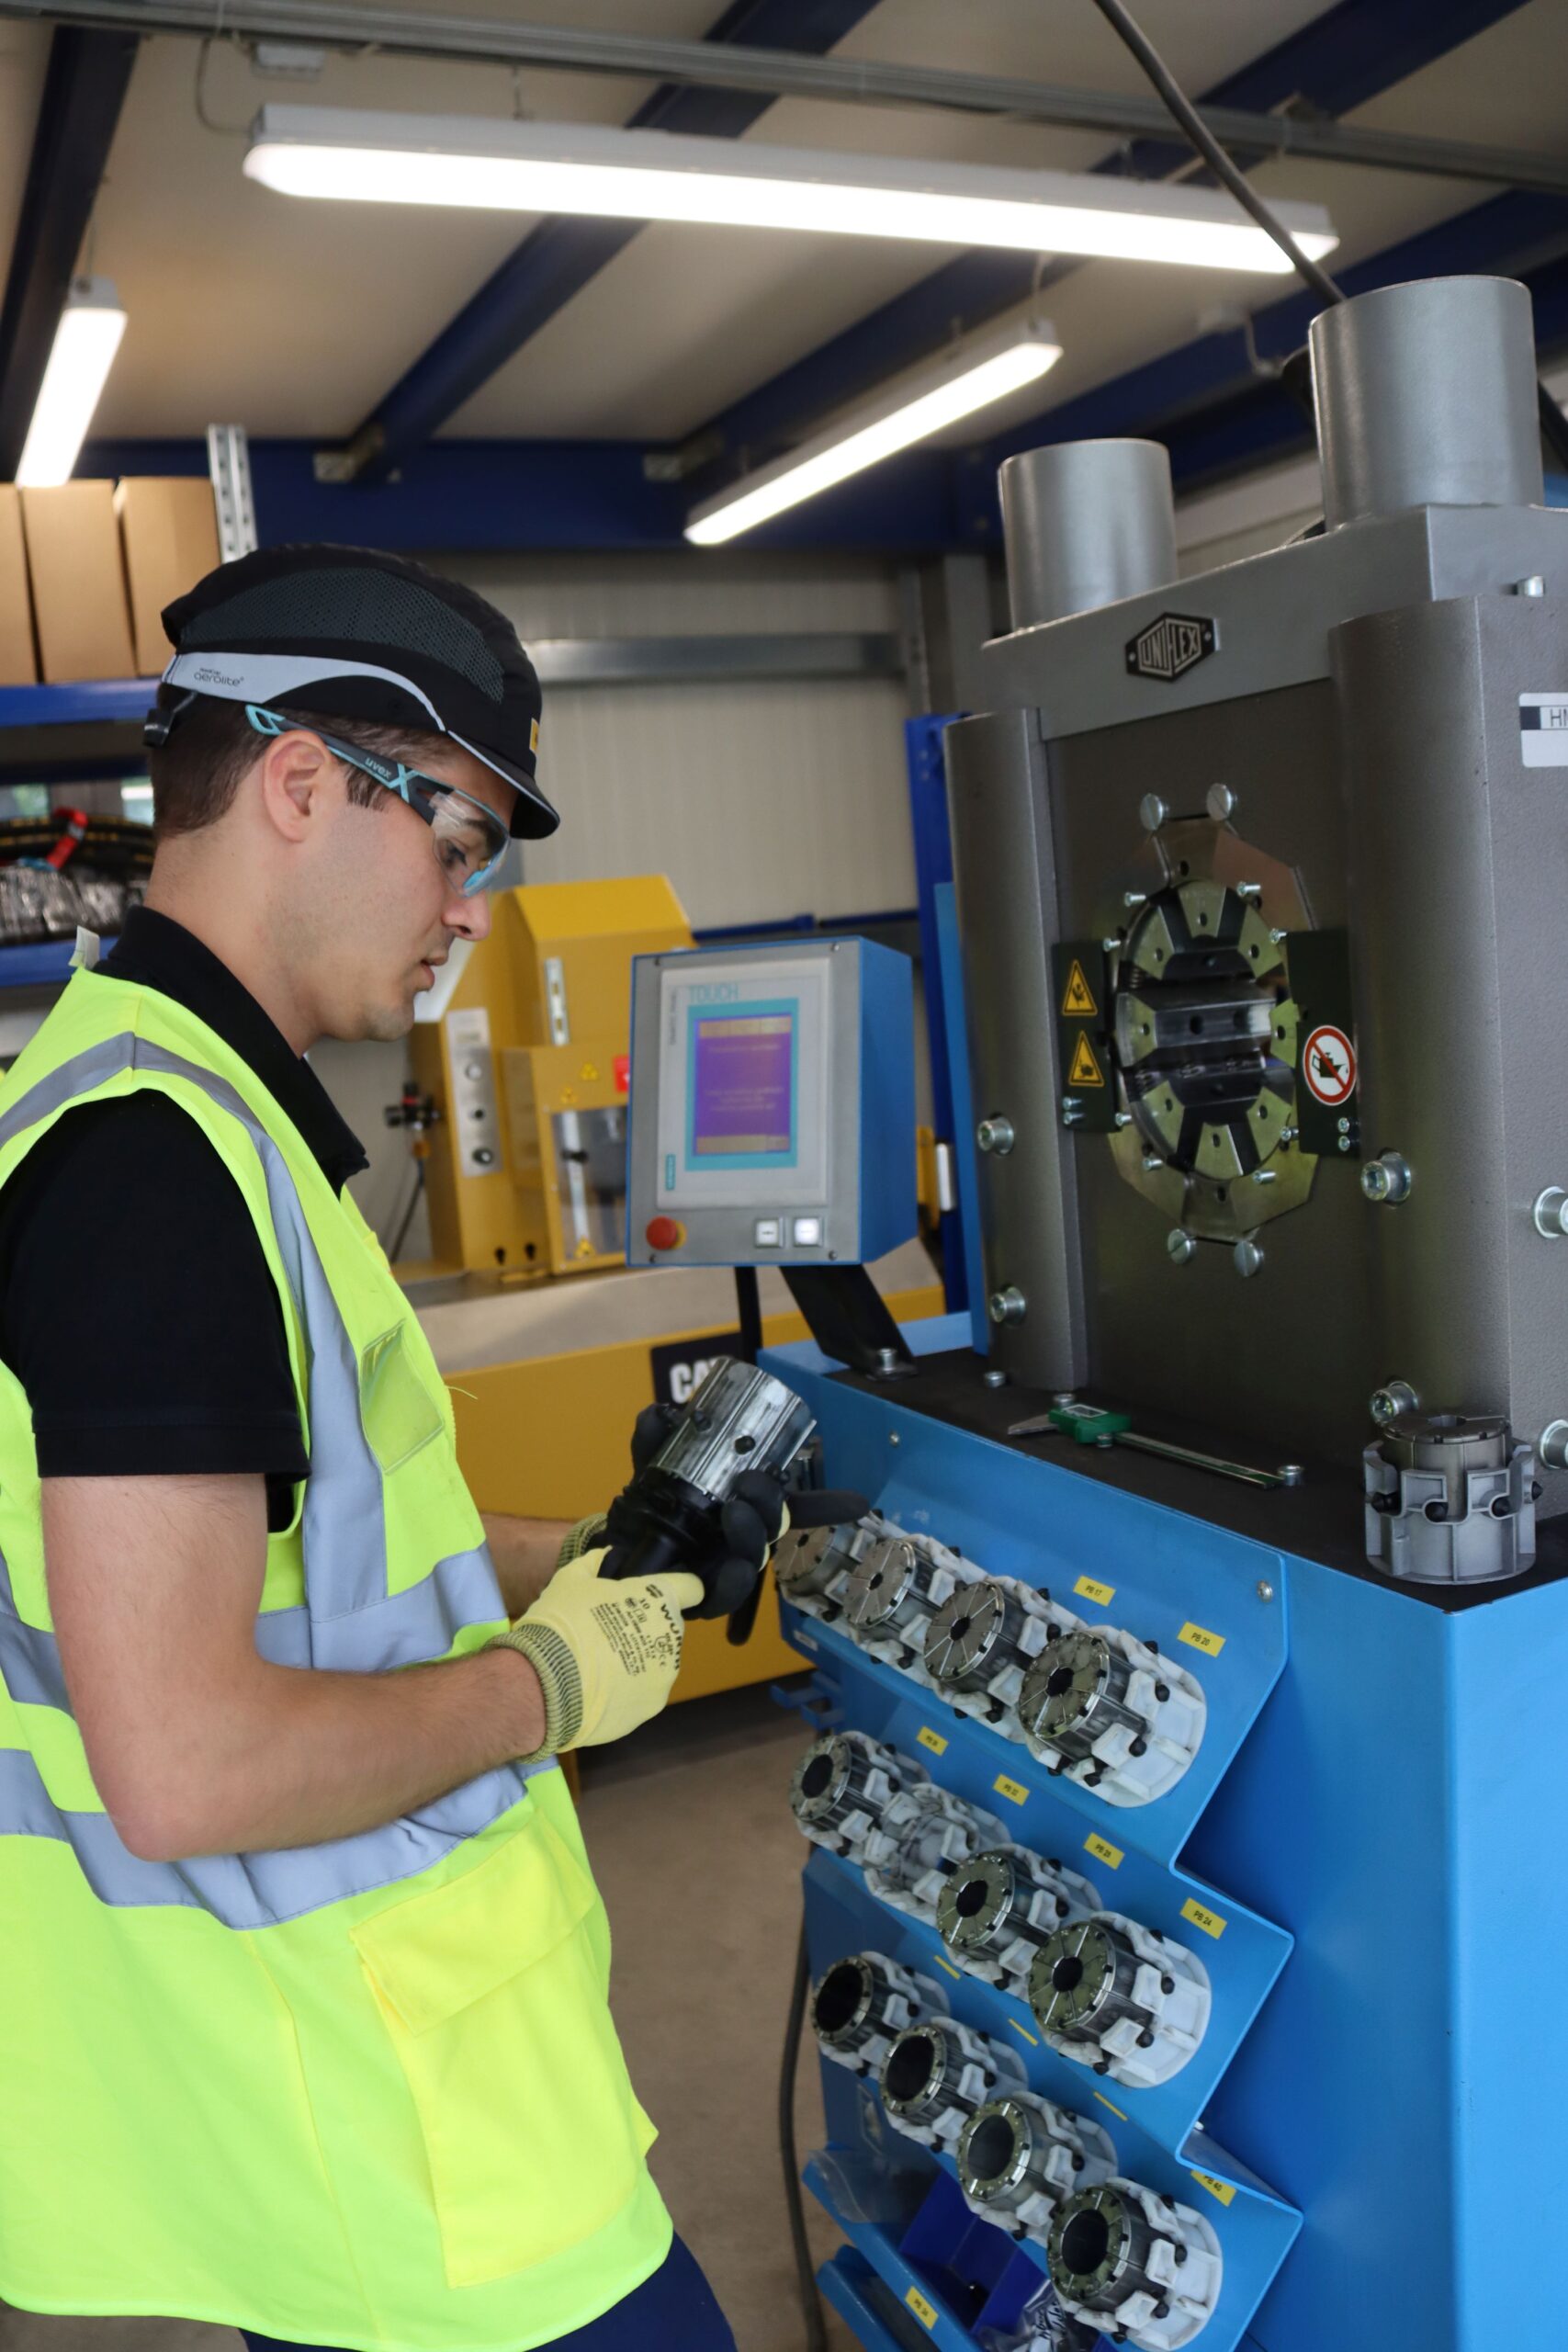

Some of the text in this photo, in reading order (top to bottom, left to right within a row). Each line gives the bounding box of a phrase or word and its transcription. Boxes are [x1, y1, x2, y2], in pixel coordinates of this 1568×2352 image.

[366, 757, 391, 778] uvex
[689, 983, 739, 1002] TOUCH
[670, 1358, 718, 1404] CA
[640, 1599, 650, 1610] 10
[1191, 1633, 1211, 1646] PB 20
[1095, 1843, 1104, 1853] PB
[1193, 1910, 1213, 1926] PB 24
